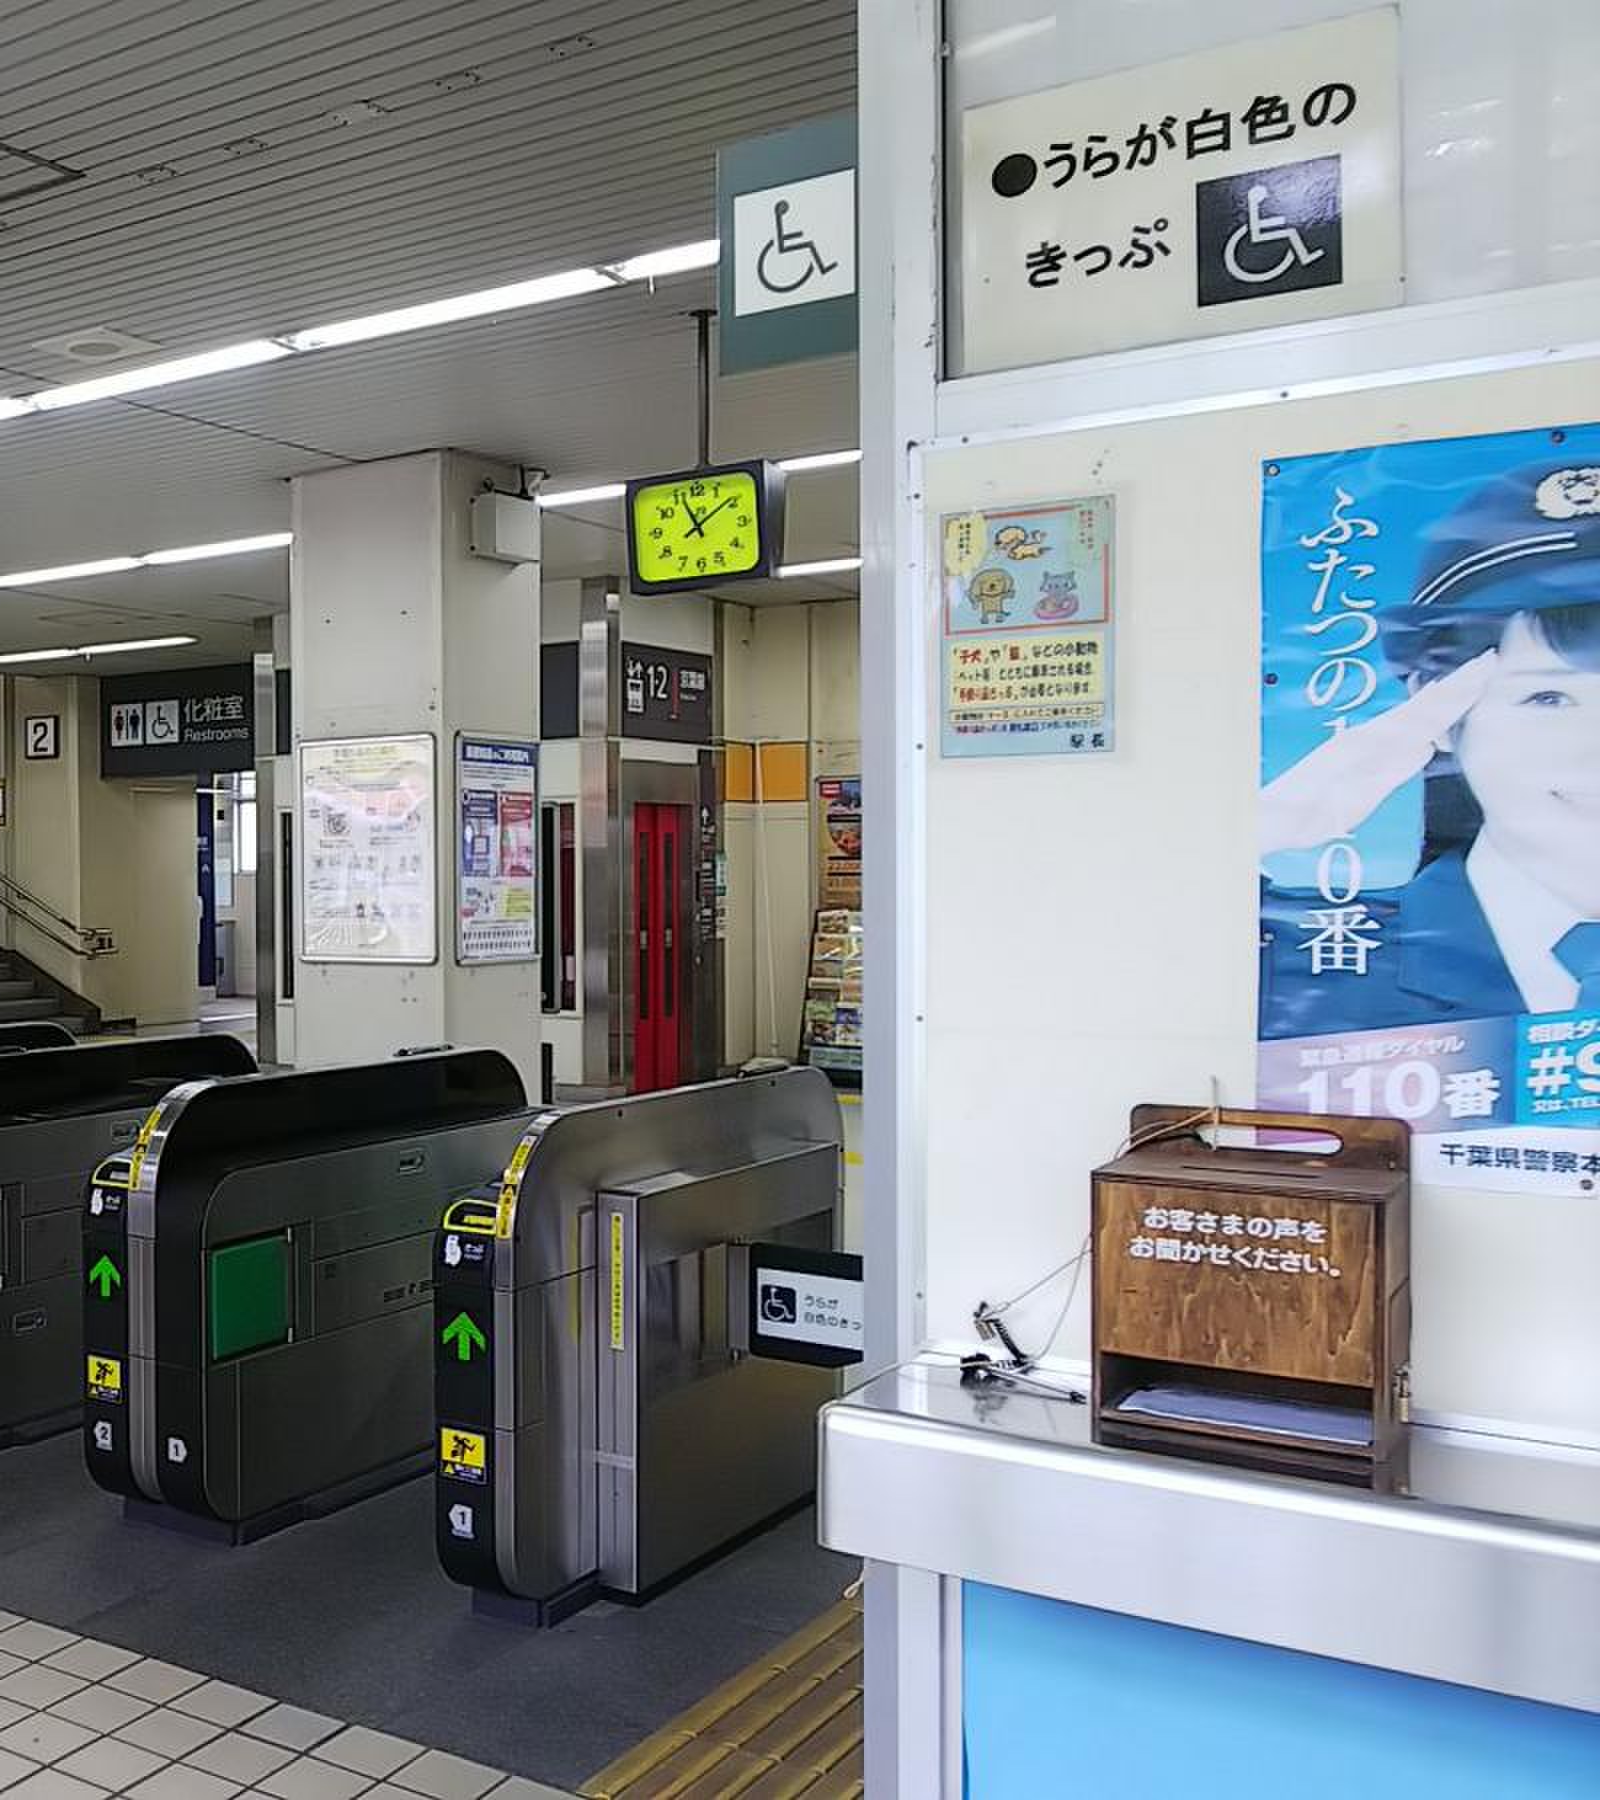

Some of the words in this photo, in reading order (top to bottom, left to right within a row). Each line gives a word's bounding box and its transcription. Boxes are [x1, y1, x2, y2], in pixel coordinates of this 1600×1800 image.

[1026, 217, 1171, 289] きっぷ
[33, 722, 48, 752] 2
[1299, 486, 1384, 976] ふたつの0番
[1299, 1059, 1502, 1119] 110番
[1143, 1206, 1328, 1244] お客さまの声を
[1129, 1235, 1341, 1278] お聞かせください。
